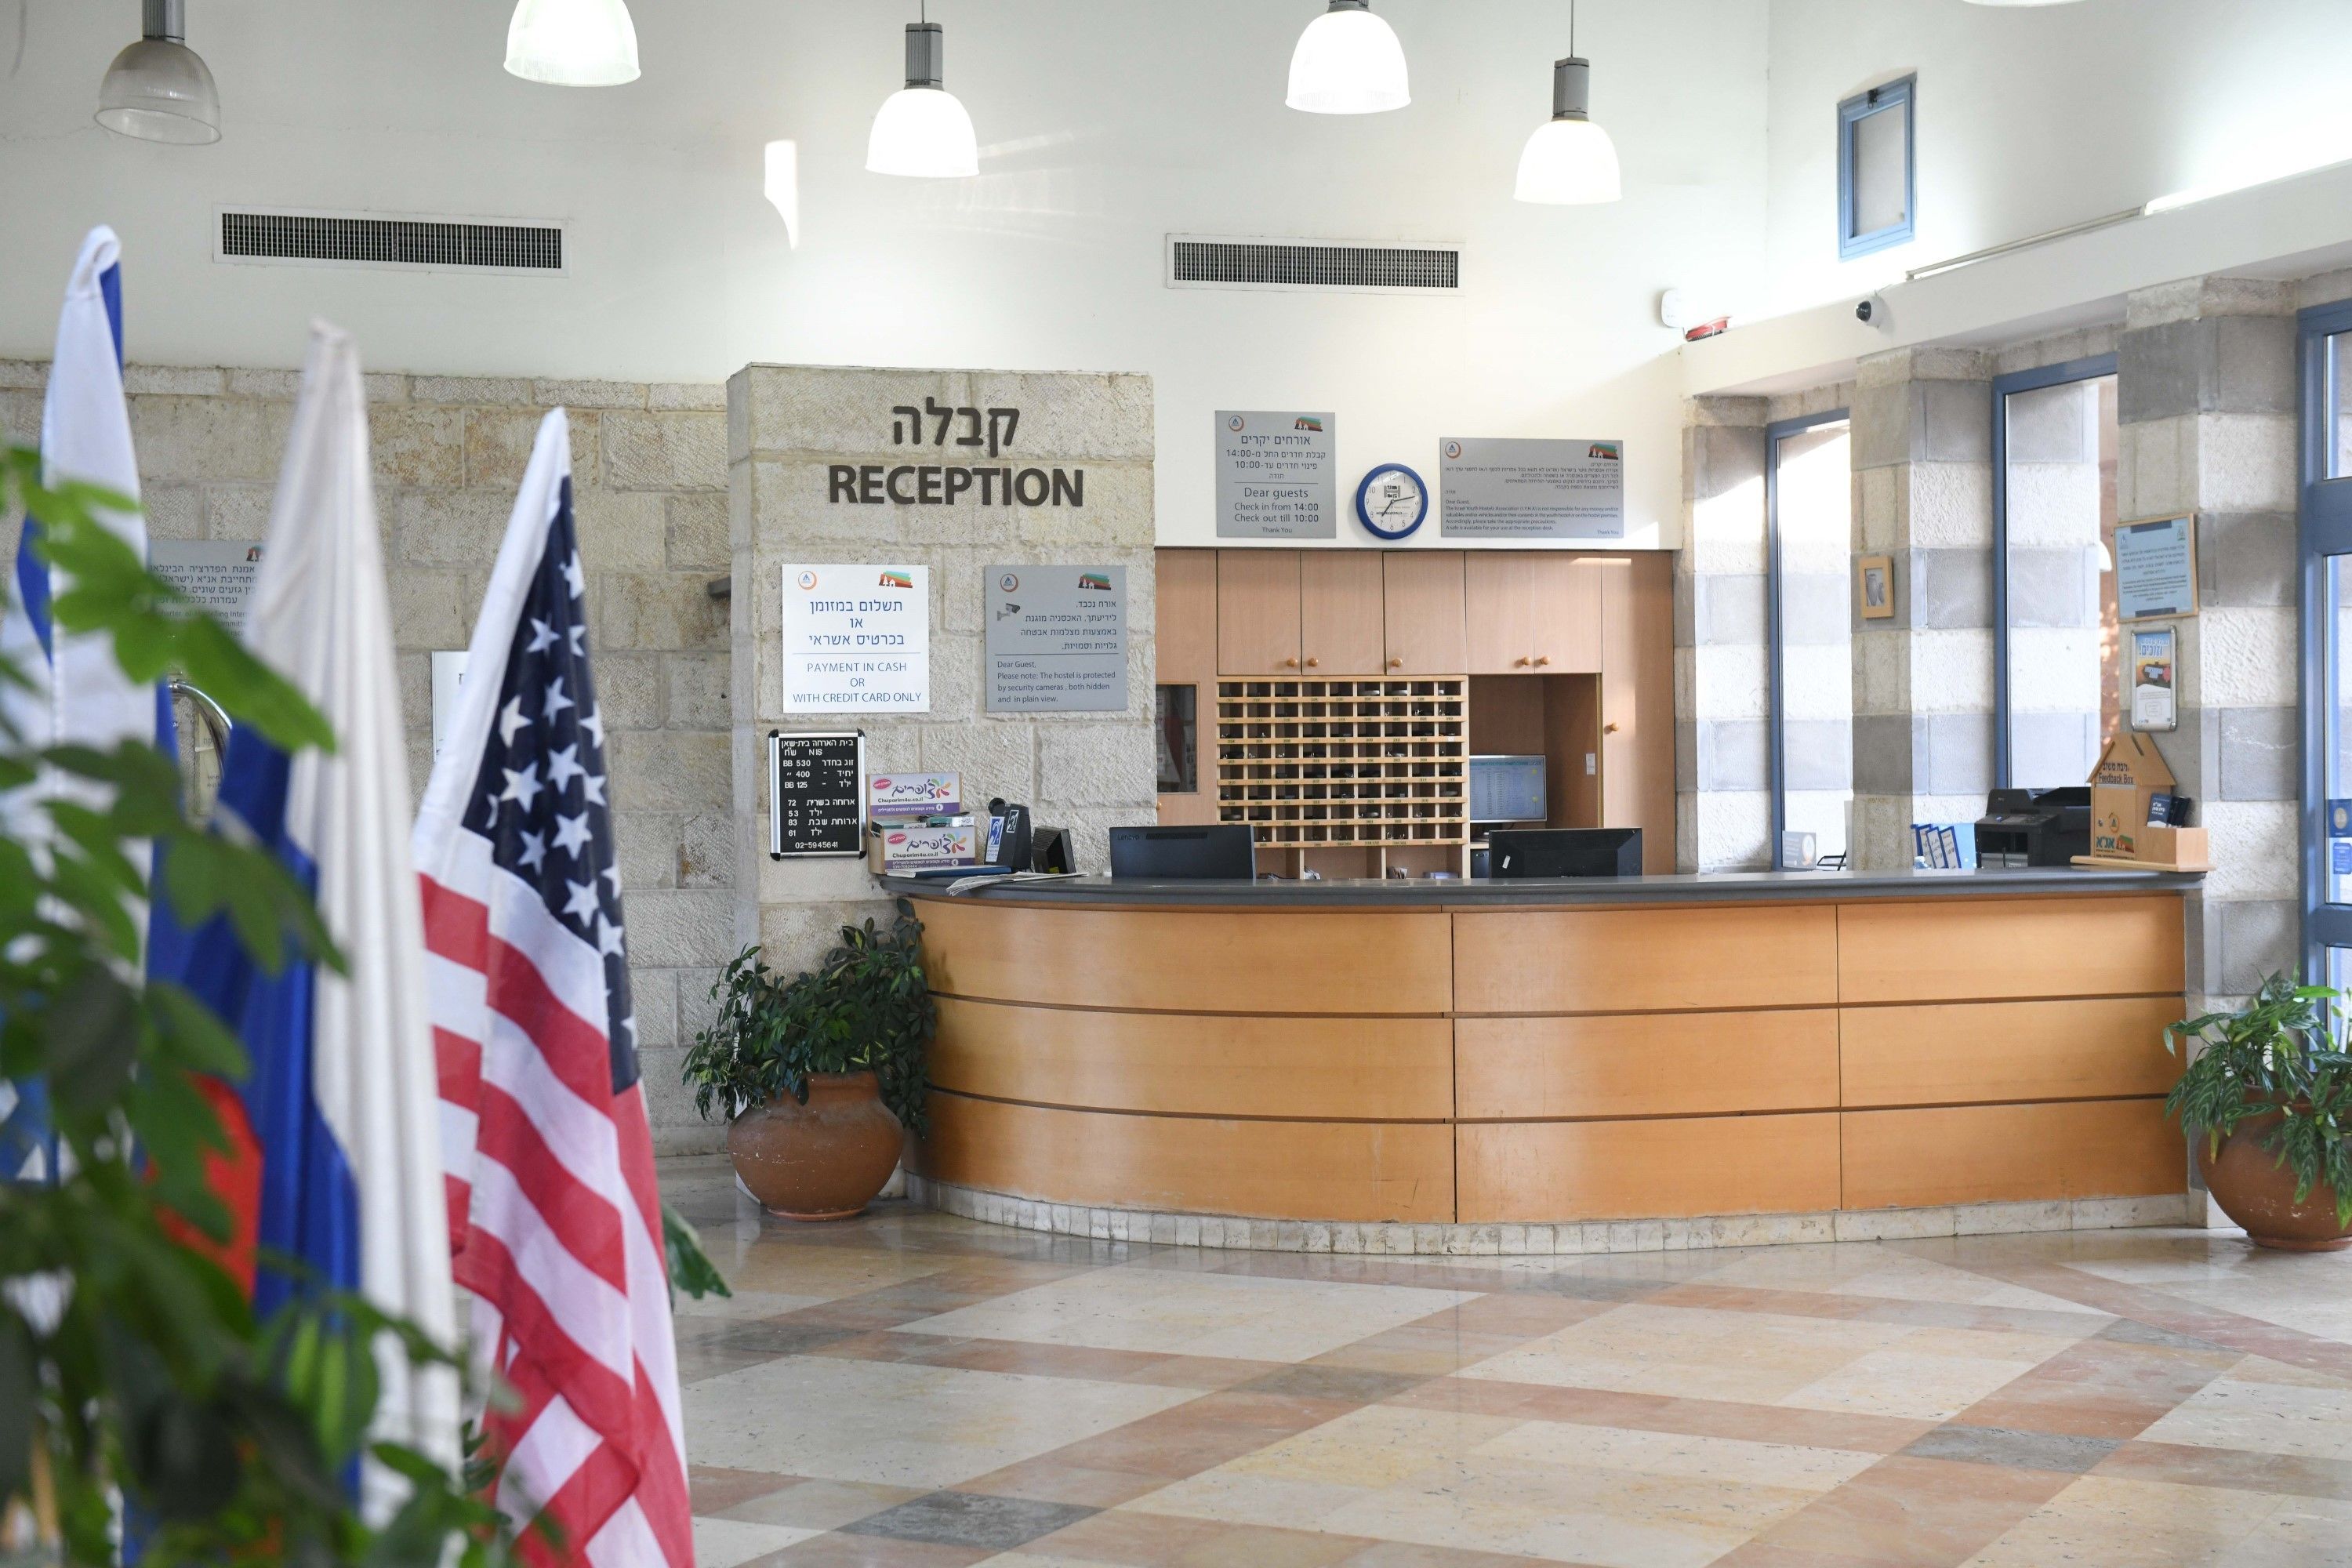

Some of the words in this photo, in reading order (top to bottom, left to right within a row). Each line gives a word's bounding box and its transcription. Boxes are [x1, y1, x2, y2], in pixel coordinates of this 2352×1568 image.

[893, 396, 1020, 458] קבלה
[1241, 435, 1270, 447] יקרים
[1275, 436, 1311, 445] אורחים
[1306, 451, 1326, 459] קבלת
[829, 465, 1083, 507] RECEPTION
[1244, 488, 1269, 497] Dear
[1272, 488, 1308, 499] guests
[1272, 503, 1291, 511] from
[1234, 514, 1260, 522] Check
[810, 601, 853, 615] במזומן
[859, 599, 902, 612] תשלום
[850, 618, 863, 628] או
[809, 635, 851, 646] אשראי
[857, 634, 905, 646] בכרטיס
[807, 662, 859, 673] PAYMENT
[863, 663, 873, 672] IN
[877, 662, 906, 672] CASH
[1014, 660, 1036, 669] Guest,
[1083, 671, 1116, 680] protected
[850, 677, 865, 687] OR
[793, 693, 820, 703] WITH
[822, 693, 859, 702] CREDIT
[862, 692, 891, 702] CARD
[893, 692, 921, 702] ONLY
[781, 740, 810, 749] בית-שאן
[2099, 772, 2122, 783] Feedback
[2124, 774, 2133, 784] Box
[809, 808, 822, 816] ילד
[811, 827, 822, 836] ילד
